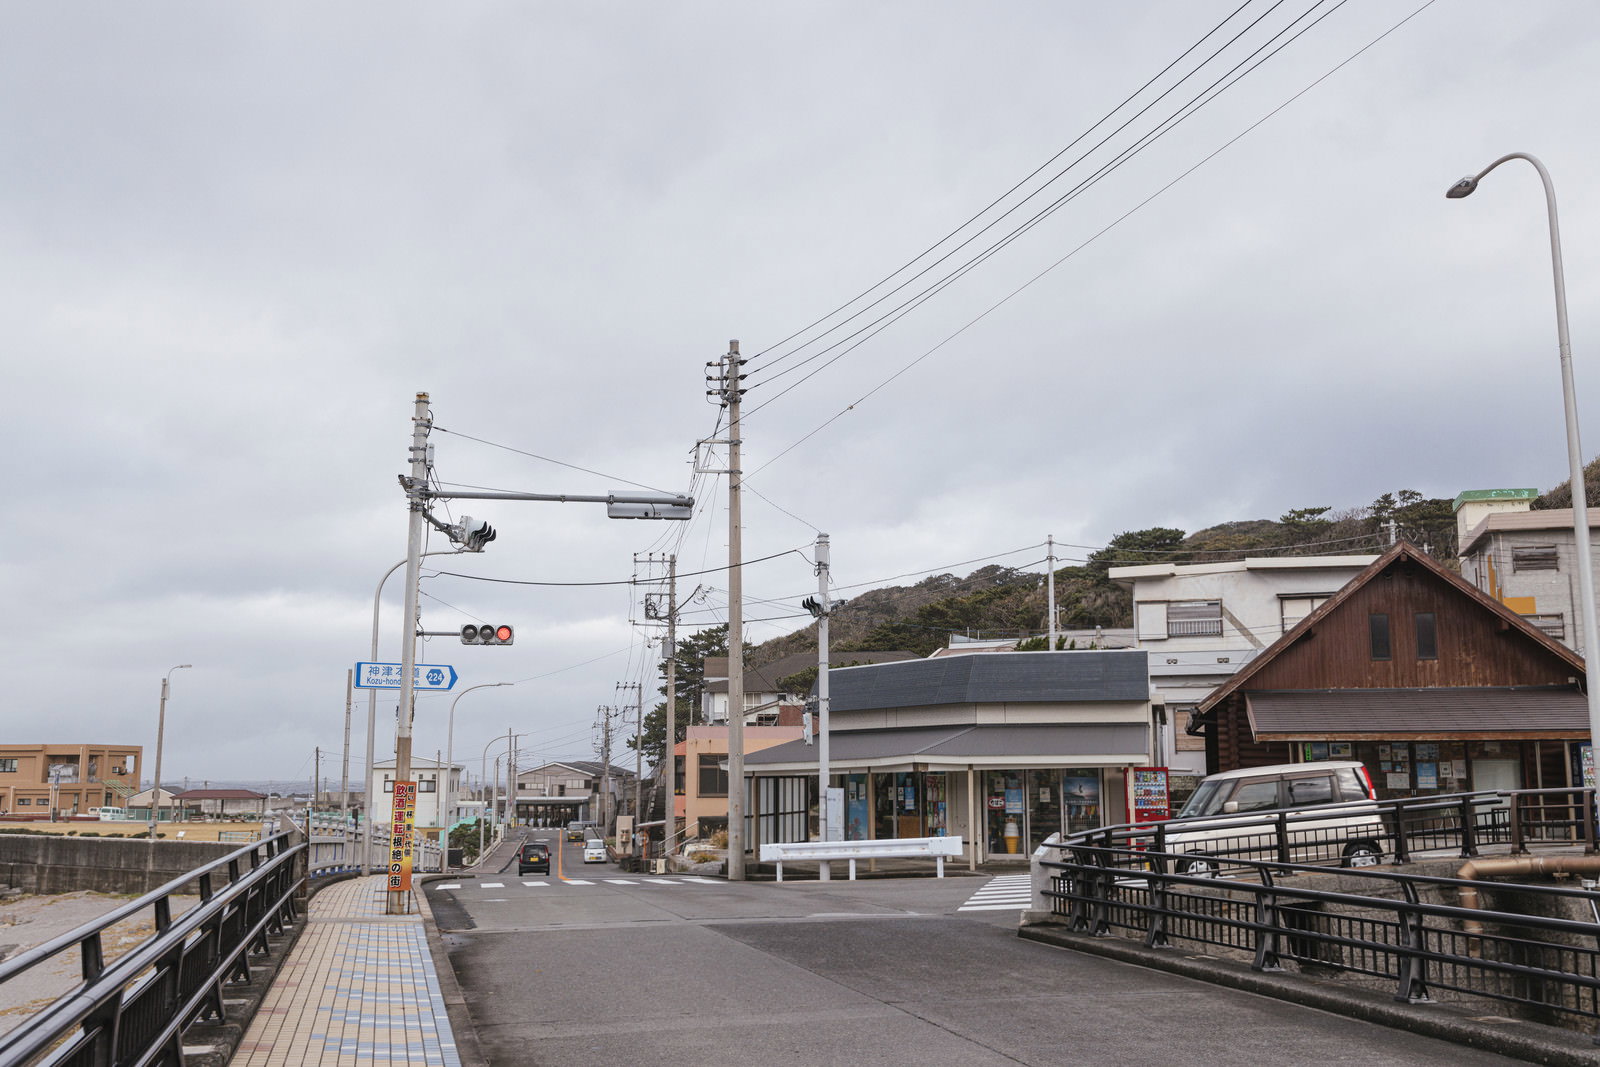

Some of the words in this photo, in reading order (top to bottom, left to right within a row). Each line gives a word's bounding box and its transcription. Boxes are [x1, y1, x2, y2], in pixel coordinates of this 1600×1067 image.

[428, 672, 442, 682] 224
[406, 785, 415, 819] 軽い一杯
[390, 784, 406, 887] 飲酒運転根絶の街
